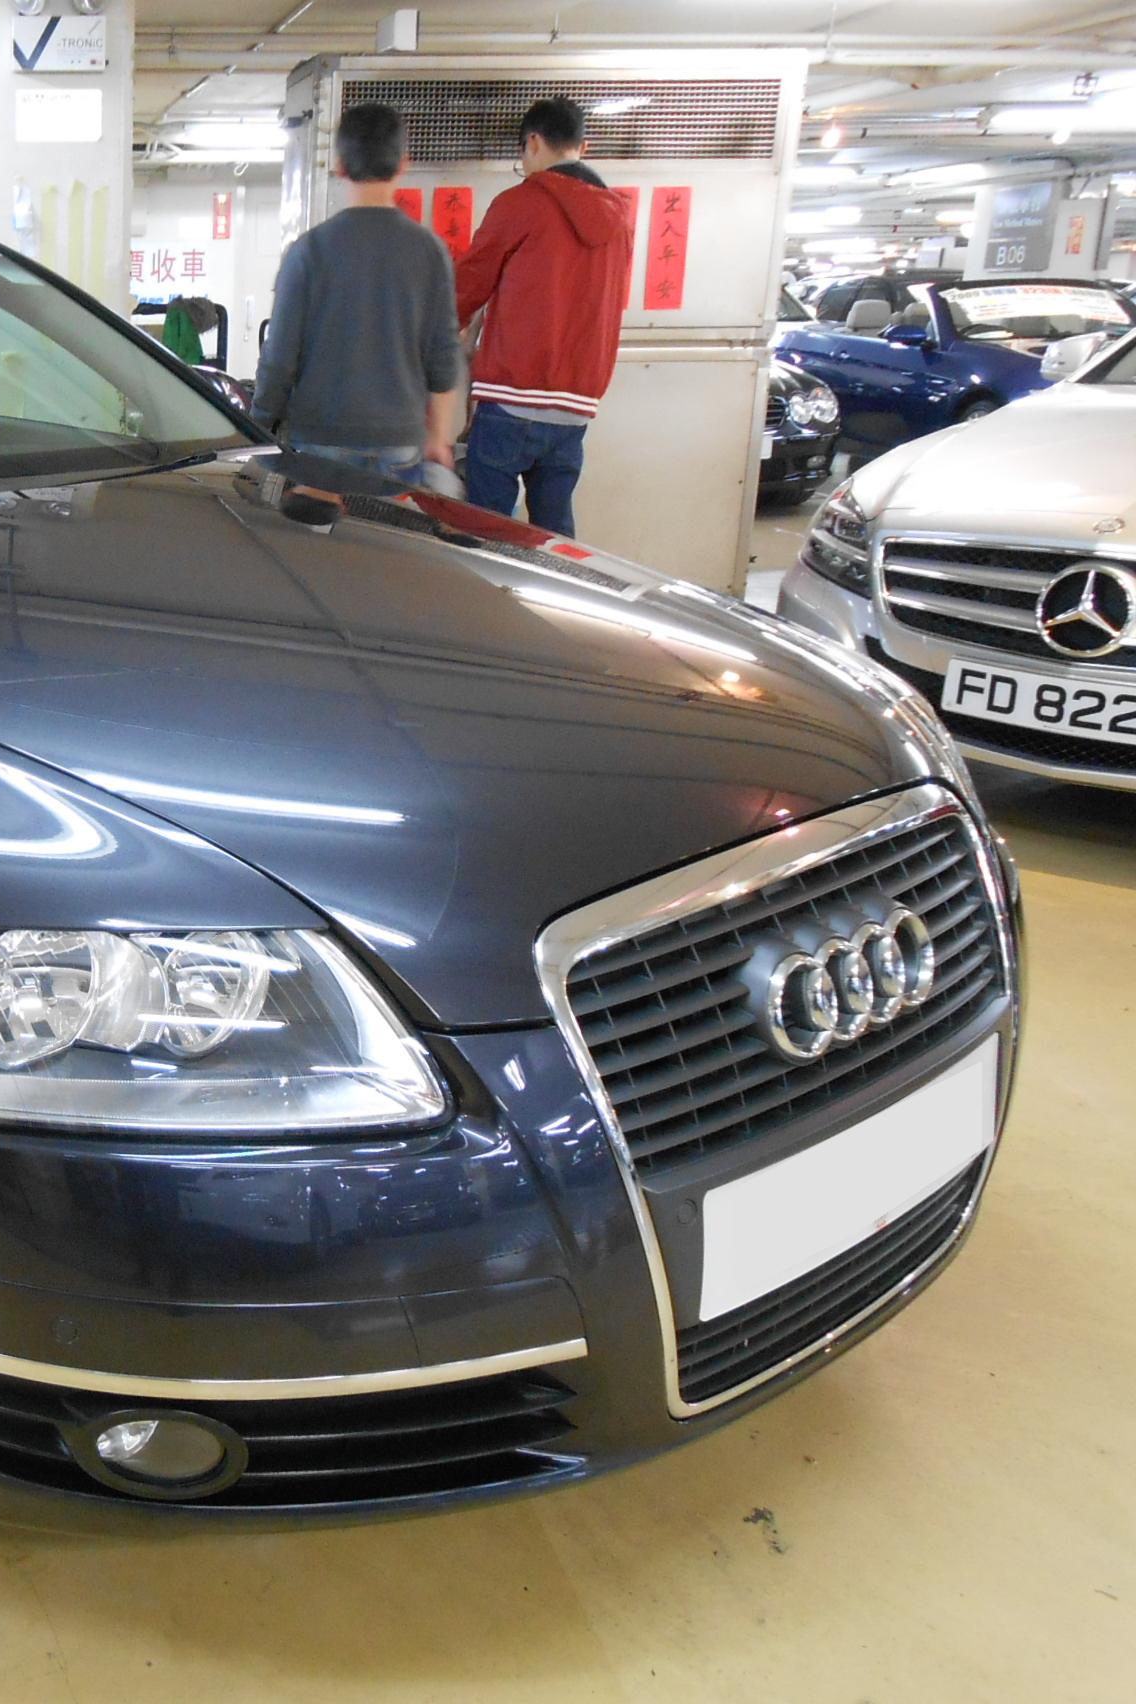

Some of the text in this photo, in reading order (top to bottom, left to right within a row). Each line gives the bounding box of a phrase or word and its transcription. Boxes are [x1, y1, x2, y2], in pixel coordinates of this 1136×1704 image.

[655, 191, 683, 300] 出入平安
[956, 668, 1136, 734] FD 822
